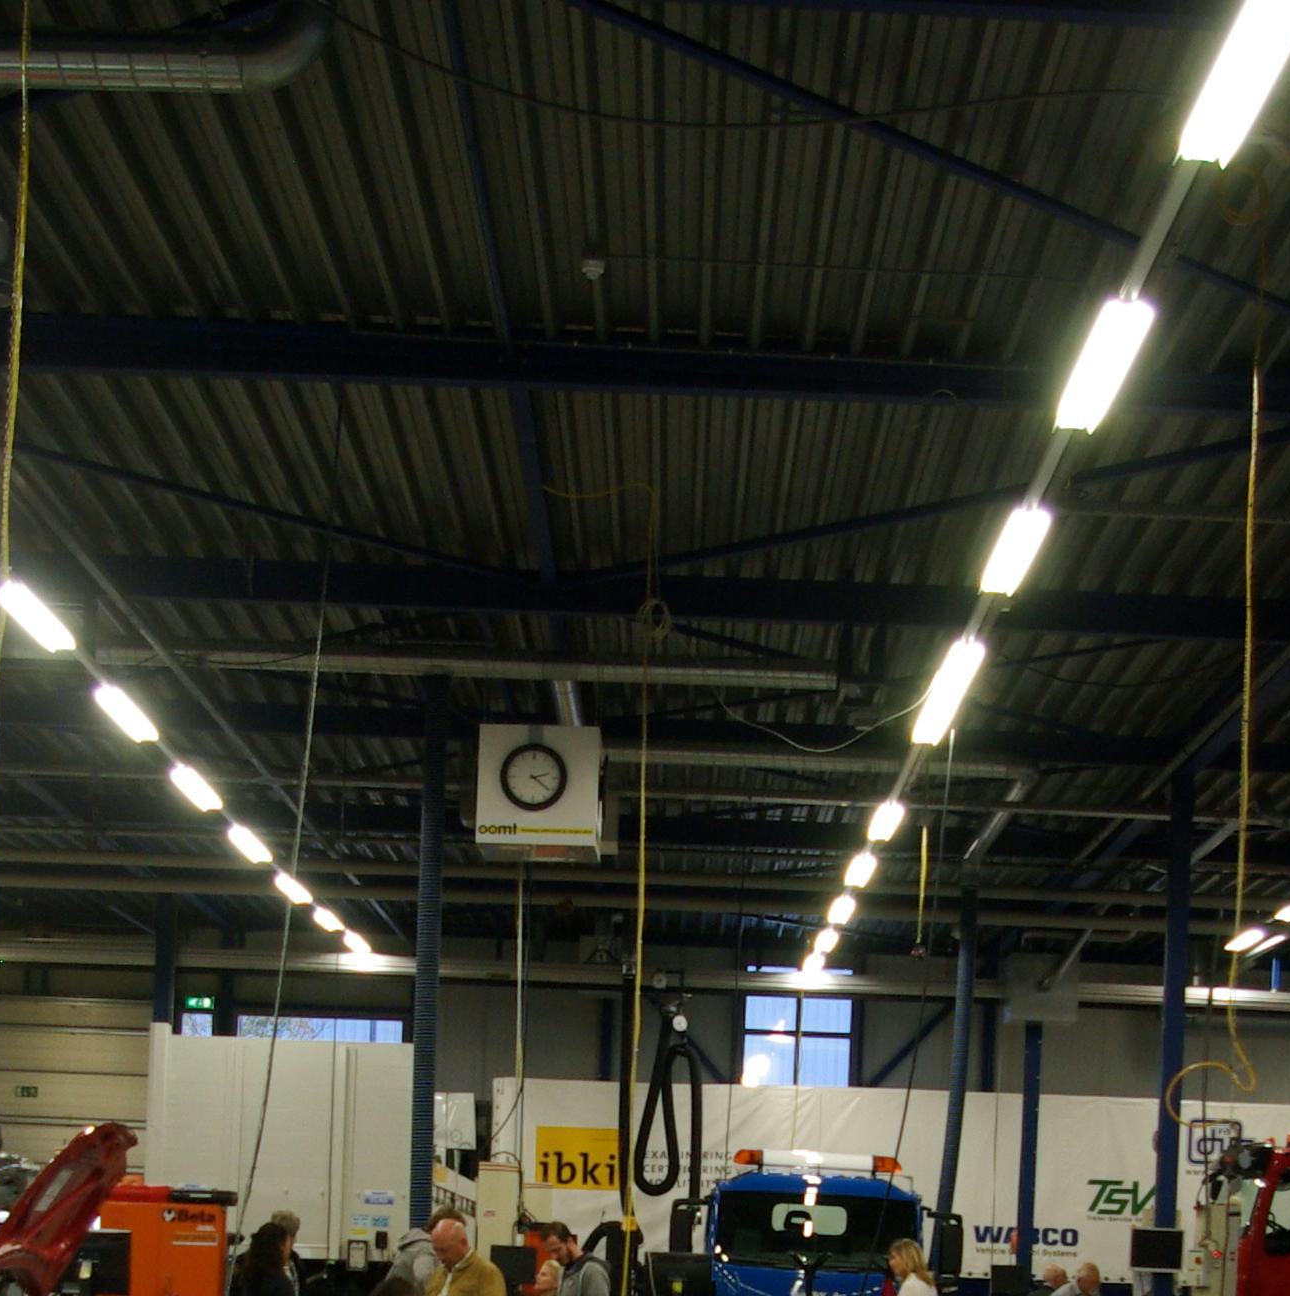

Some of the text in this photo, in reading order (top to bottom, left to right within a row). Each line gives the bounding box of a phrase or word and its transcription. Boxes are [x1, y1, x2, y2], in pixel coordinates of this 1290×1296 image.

[478, 823, 517, 835] oomt
[644, 1151, 732, 1160] EXAINRING
[539, 1152, 616, 1187] ibki
[1087, 1180, 1157, 1216] TSV
[1042, 1249, 1078, 1258] Systems
